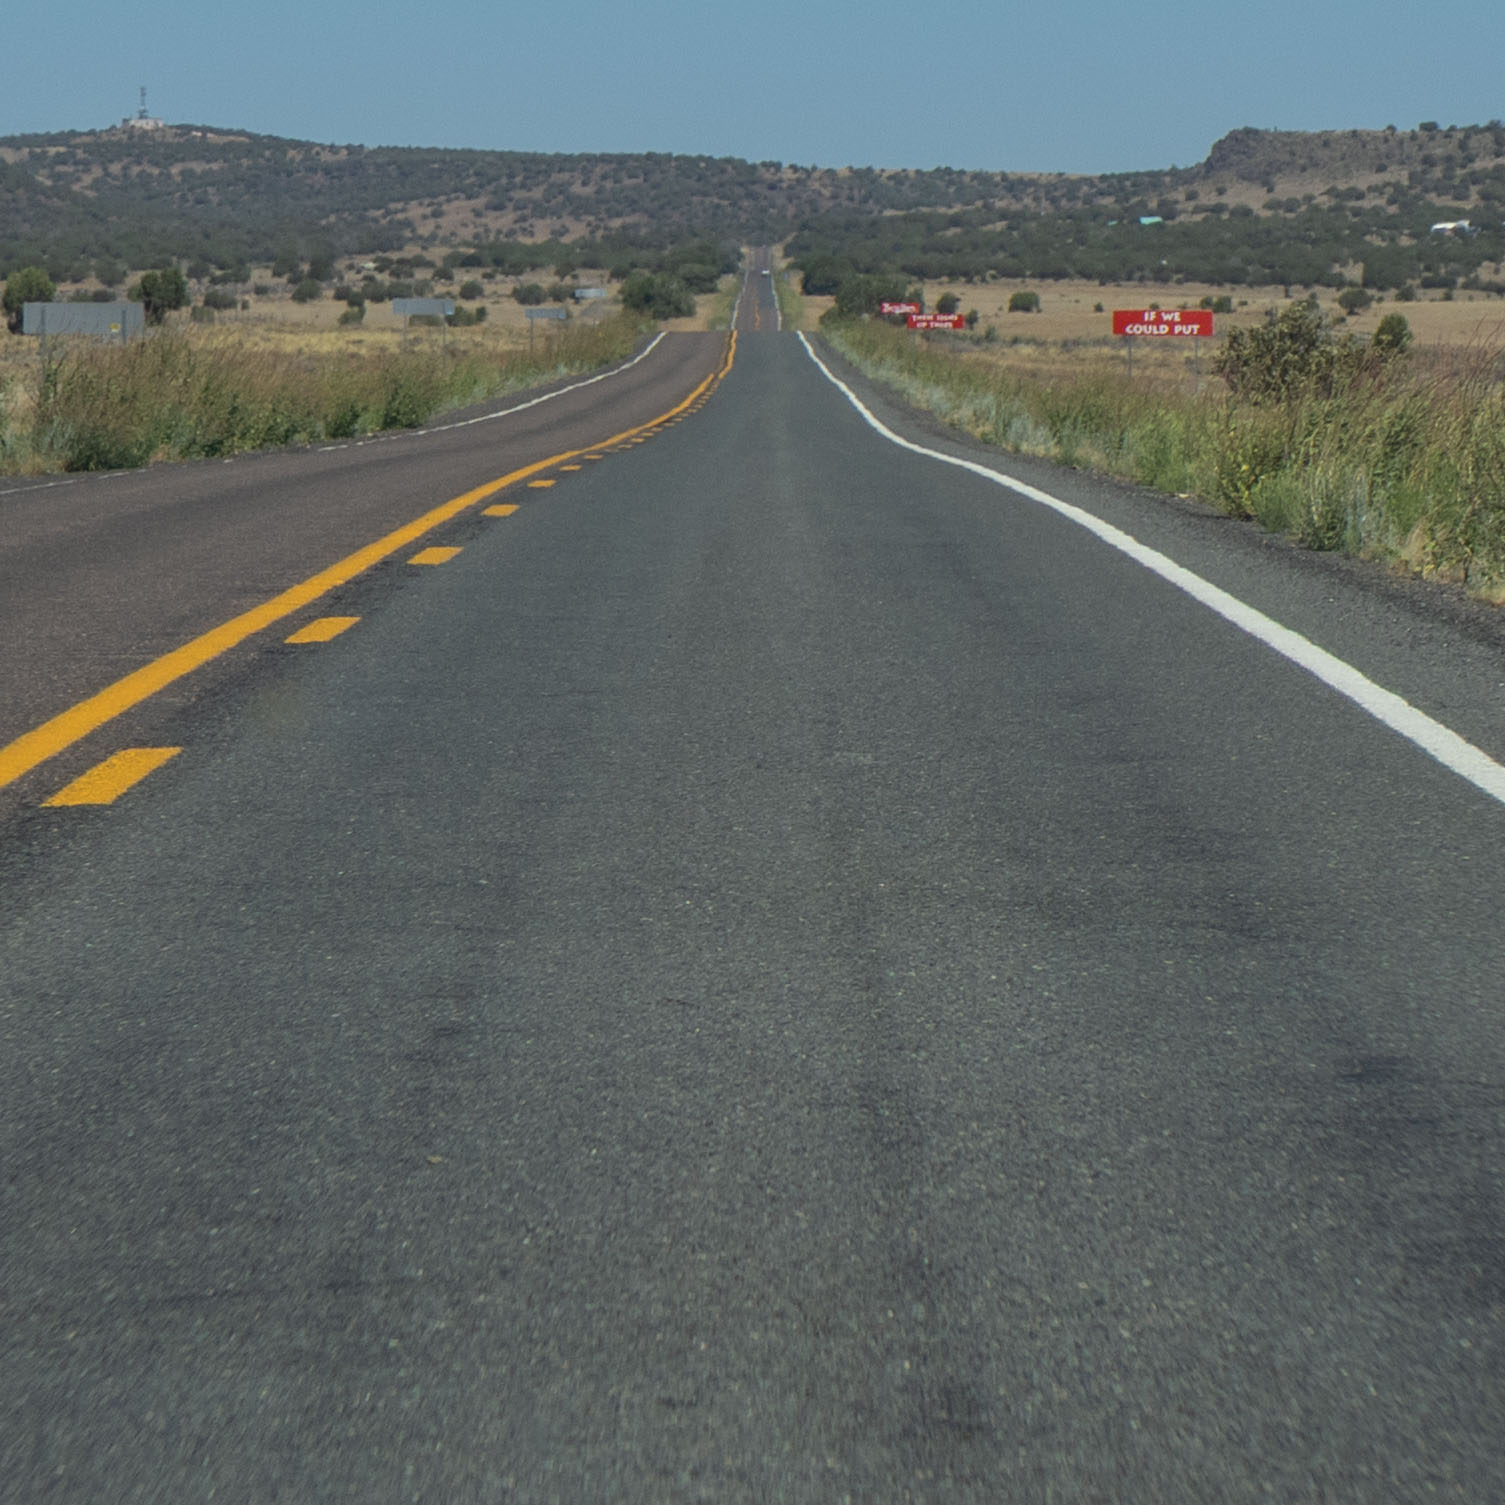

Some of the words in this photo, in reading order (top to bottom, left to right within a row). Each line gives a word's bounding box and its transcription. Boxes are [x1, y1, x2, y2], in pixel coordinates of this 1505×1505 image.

[1144, 311, 1156, 322] IF
[1161, 311, 1181, 322] WE
[1125, 324, 1169, 335] COULD
[1174, 324, 1200, 335] PUT
